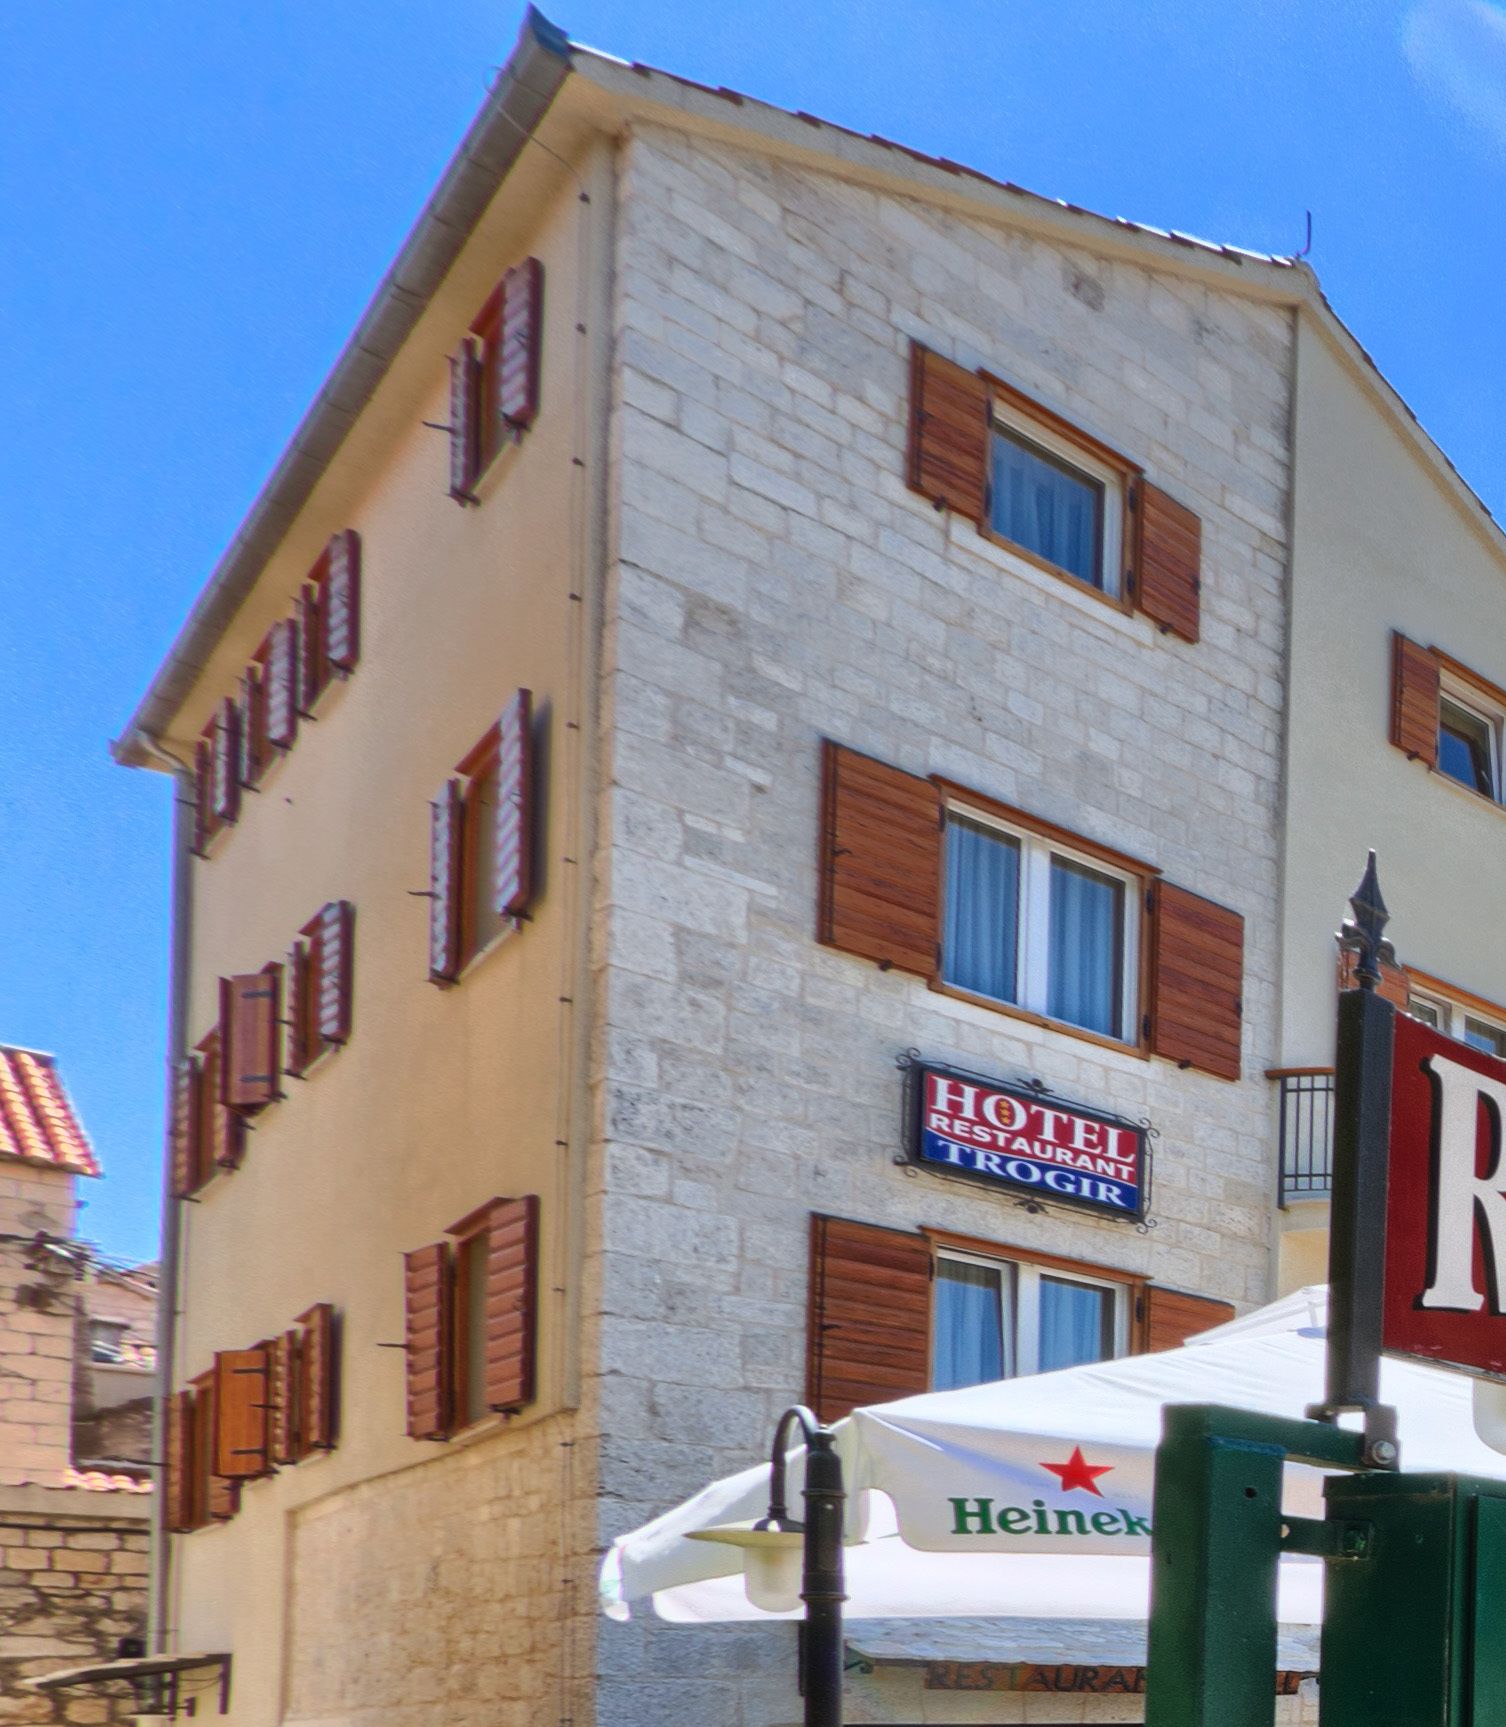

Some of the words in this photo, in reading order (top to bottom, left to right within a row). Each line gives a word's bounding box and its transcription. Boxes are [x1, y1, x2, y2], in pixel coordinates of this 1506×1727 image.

[930, 1112, 1134, 1182] RESTAURANT
[931, 1075, 1137, 1163] HOTEL
[938, 1138, 1128, 1208] TROGIR
[948, 1497, 1153, 1536] Heinek
[926, 1663, 1146, 1692] RESTAURA
